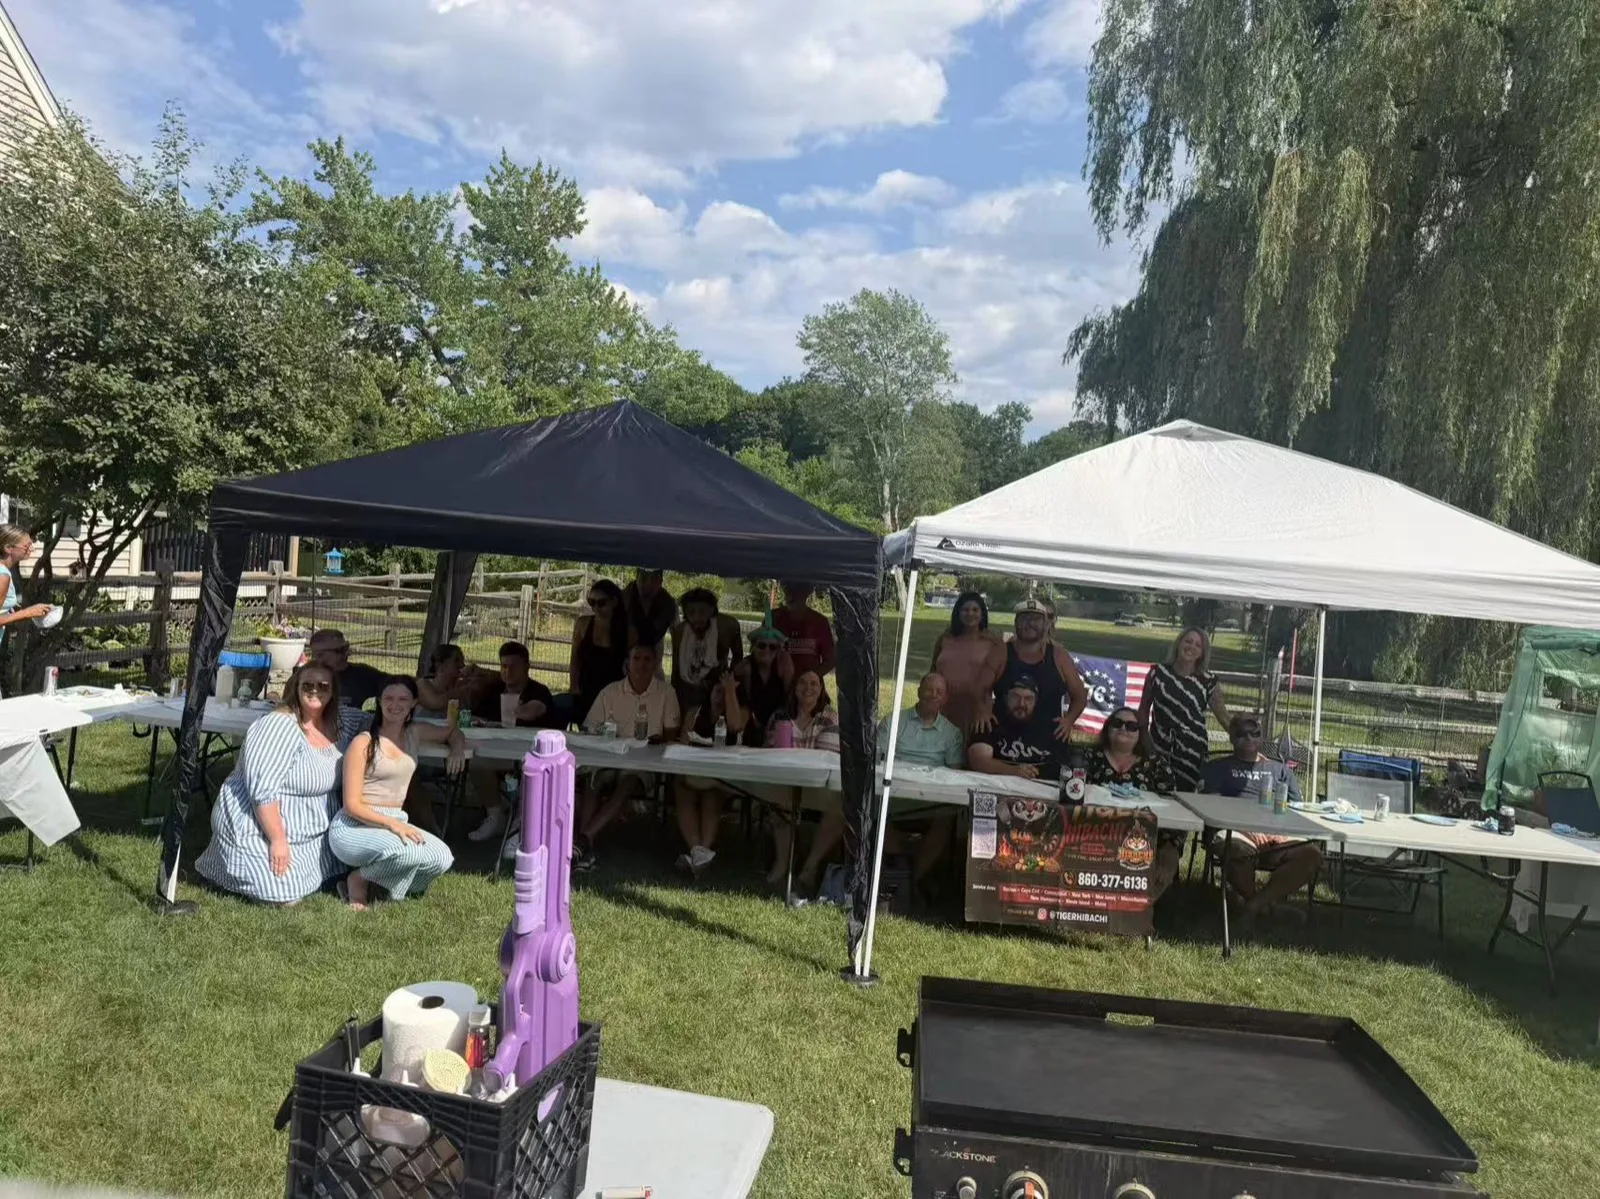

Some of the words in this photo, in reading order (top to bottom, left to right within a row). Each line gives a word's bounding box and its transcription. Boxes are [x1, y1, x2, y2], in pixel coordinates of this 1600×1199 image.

[1078, 873, 1148, 891] 860-377-6136
[1049, 909, 1108, 924] @TIGERHIBACHI
[930, 1149, 997, 1164] ACKSTONE
